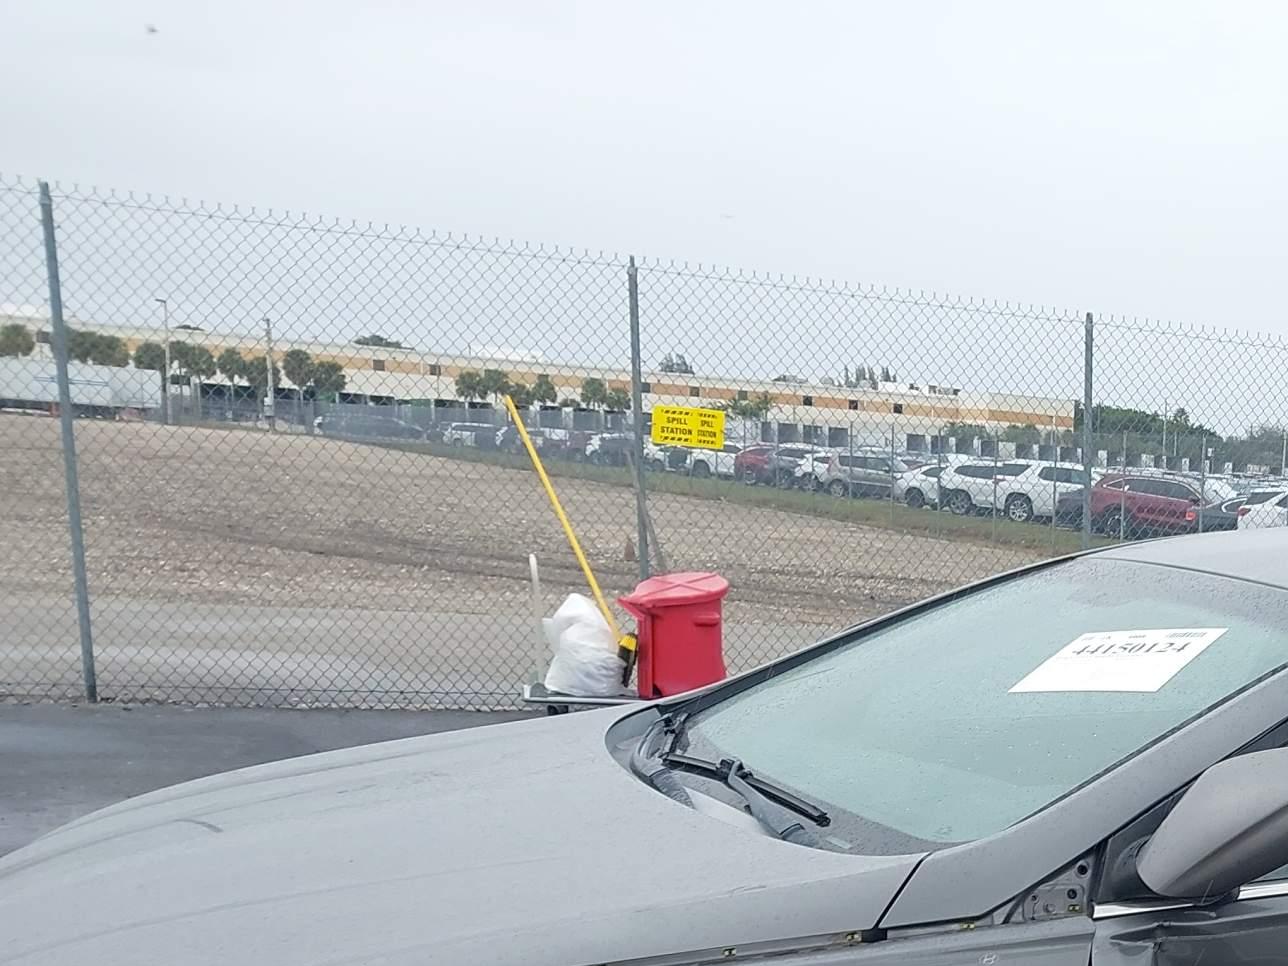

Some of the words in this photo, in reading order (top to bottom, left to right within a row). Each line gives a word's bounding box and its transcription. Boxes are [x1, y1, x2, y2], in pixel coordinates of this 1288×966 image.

[667, 417, 688, 425] SPILL
[660, 426, 692, 435] STATION
[697, 430, 716, 438] STATION
[1072, 641, 1192, 656] 44150124
